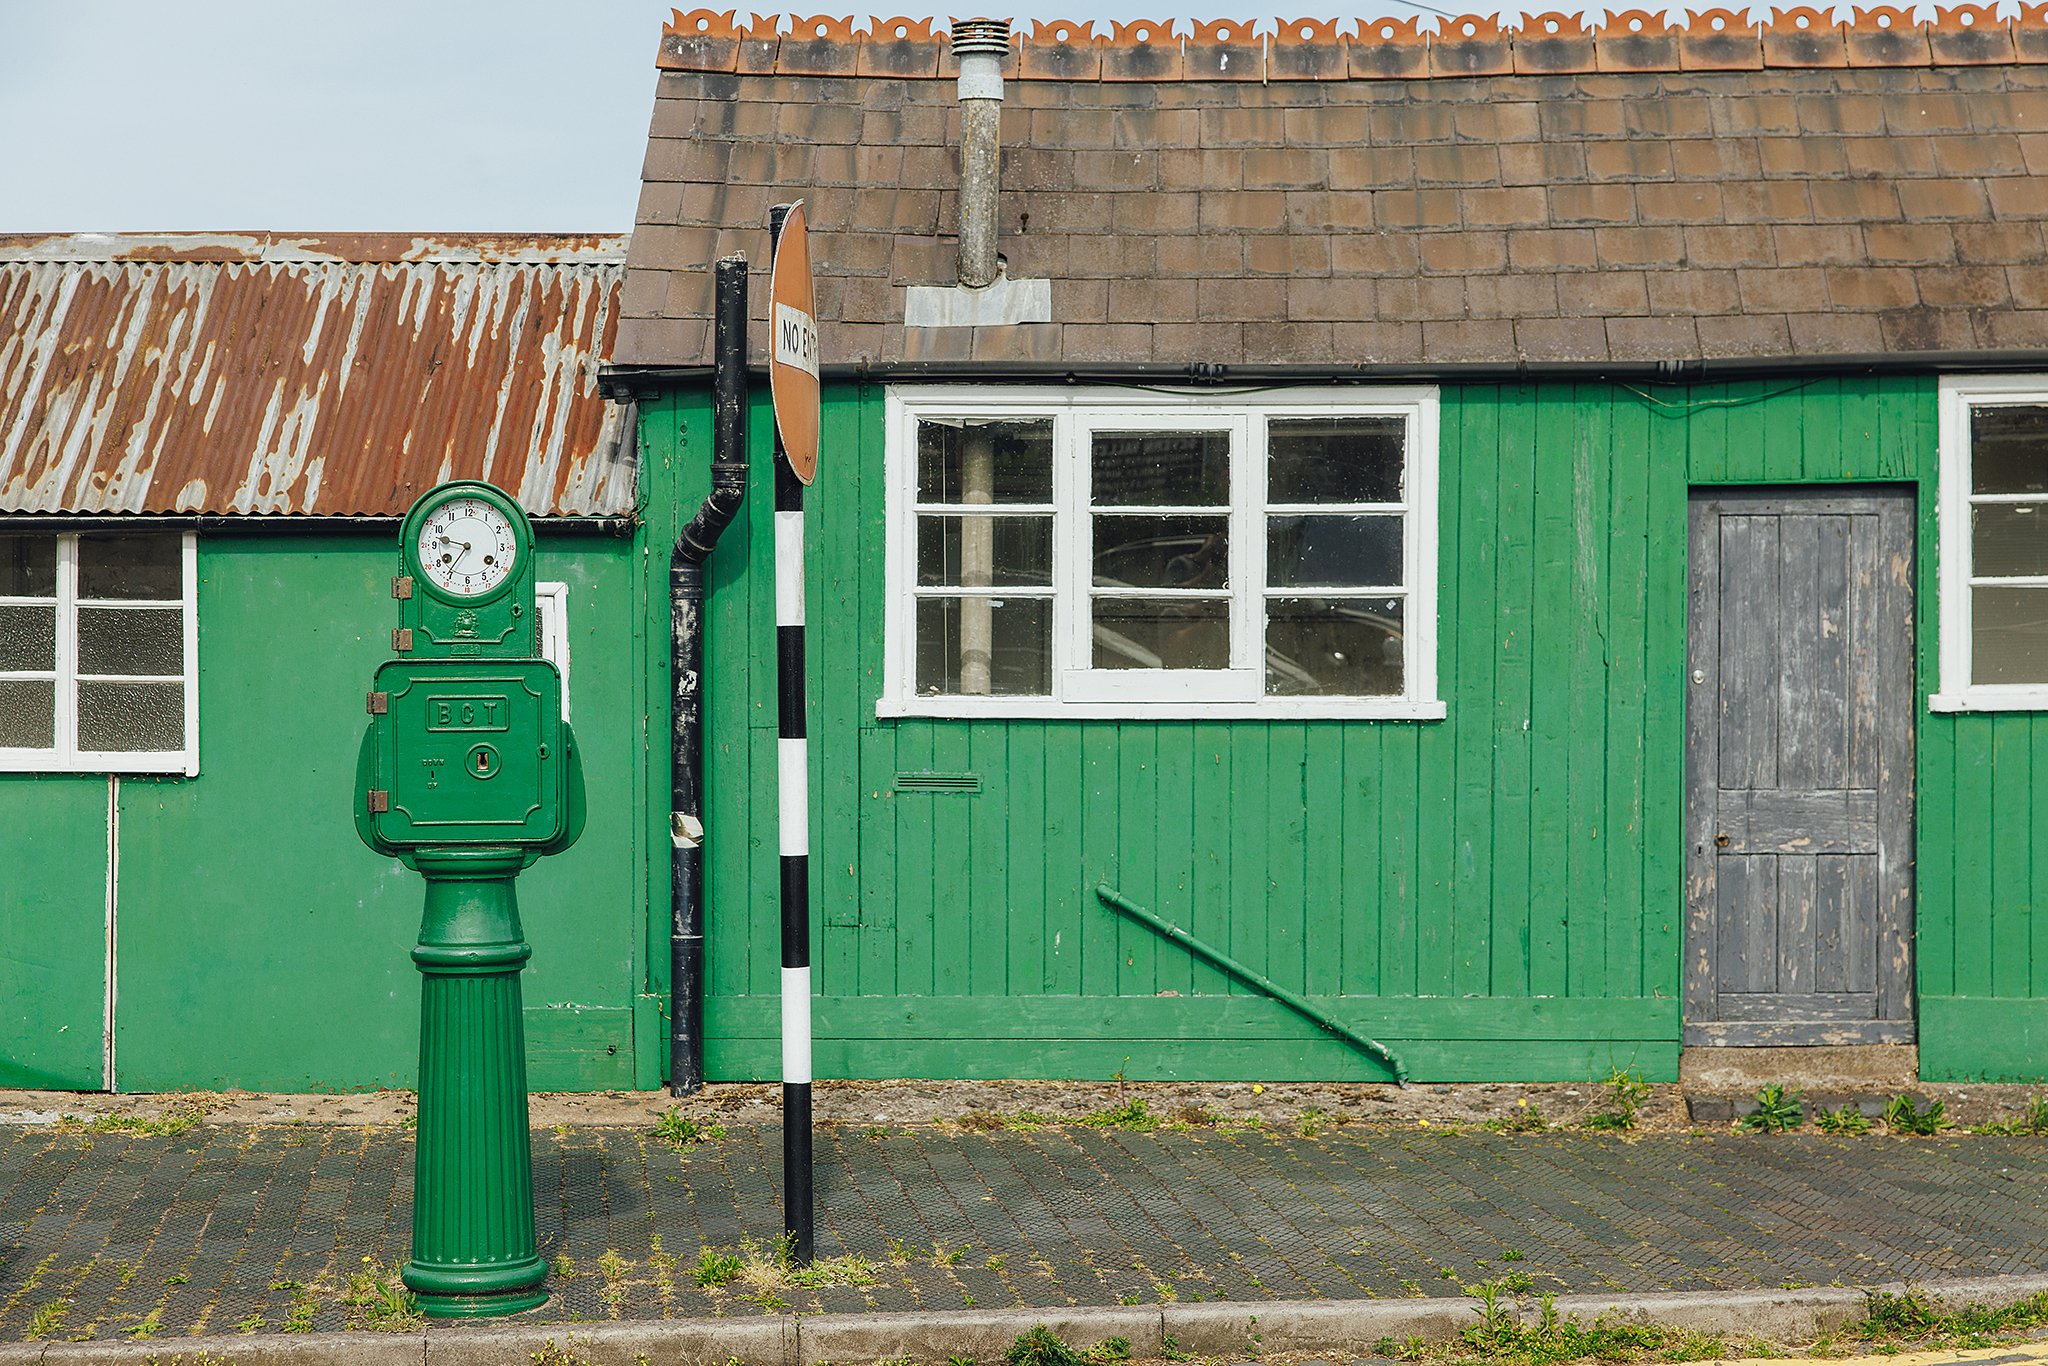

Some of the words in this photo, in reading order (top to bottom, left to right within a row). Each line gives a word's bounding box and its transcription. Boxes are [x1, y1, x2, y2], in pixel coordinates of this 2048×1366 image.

[783, 319, 799, 353] NO
[448, 512, 455, 521] 11
[464, 508, 473, 517] 12
[484, 514, 488, 522] 1
[435, 525, 443, 534] 10
[496, 526, 502, 534] 2
[432, 541, 438, 550] 9
[500, 543, 505, 552] 3
[436, 559, 442, 568] 8
[494, 560, 500, 569] 4
[447, 570, 453, 580] 7
[482, 572, 487, 581] 5
[464, 576, 471, 585] 6
